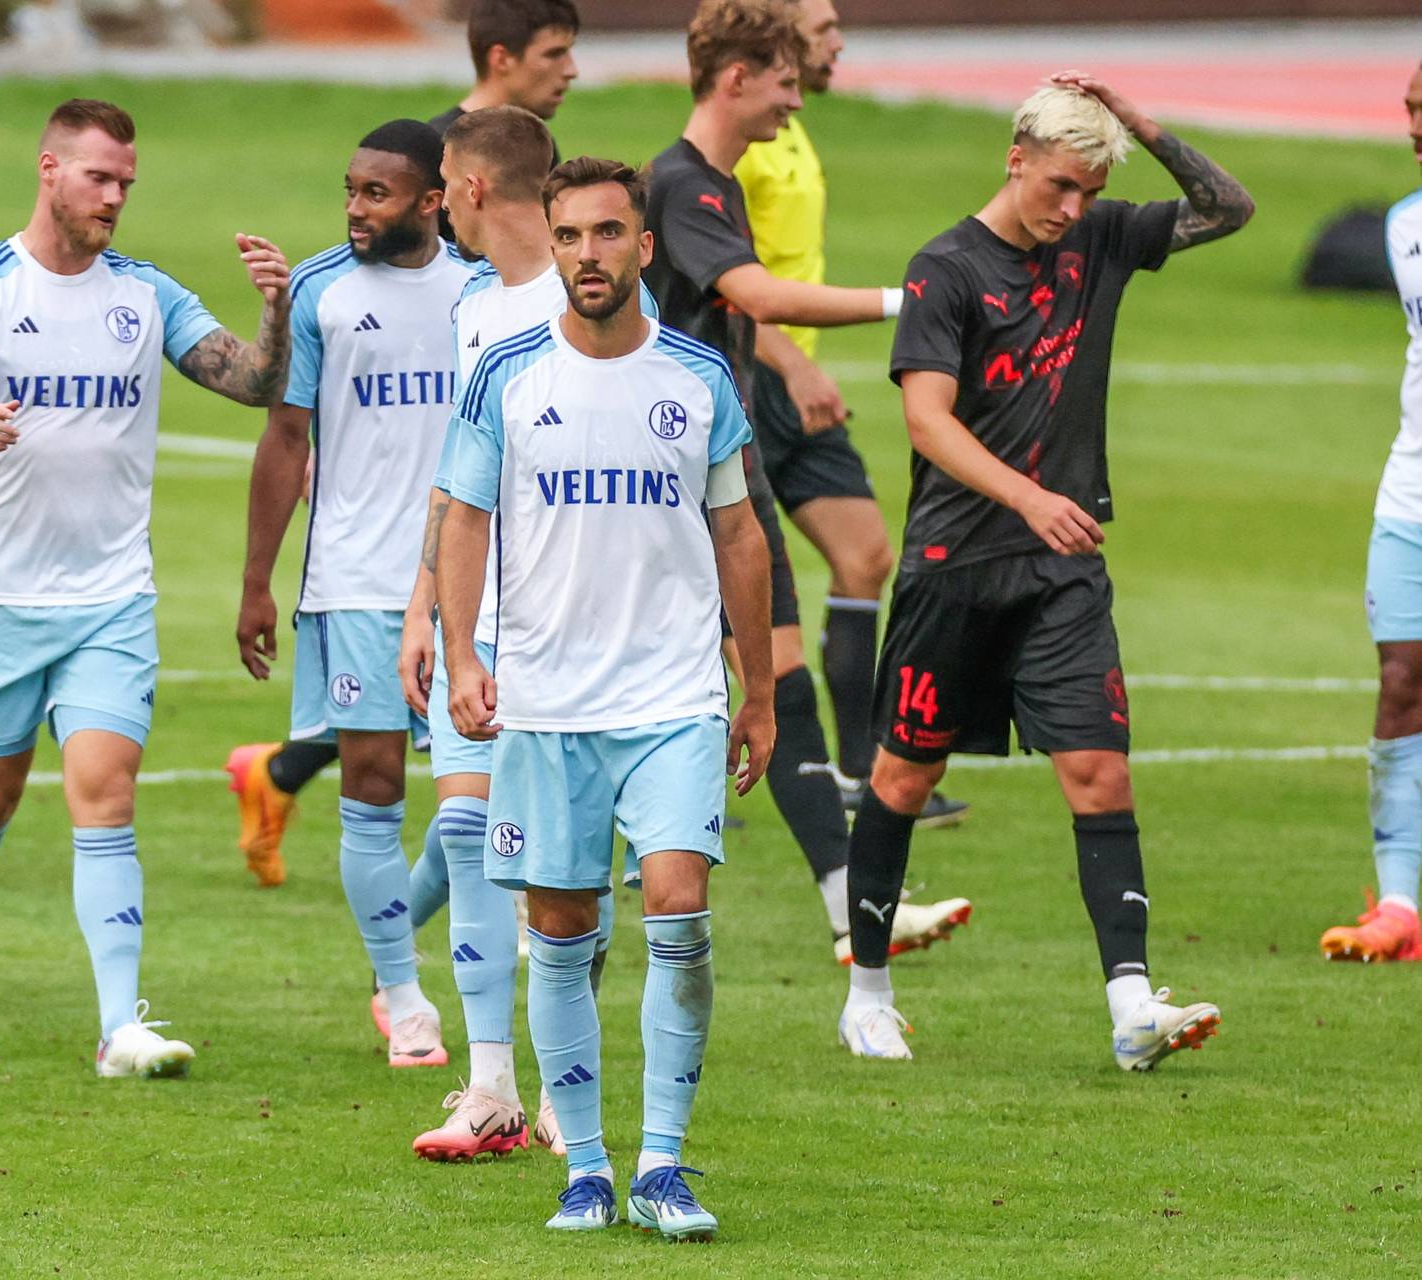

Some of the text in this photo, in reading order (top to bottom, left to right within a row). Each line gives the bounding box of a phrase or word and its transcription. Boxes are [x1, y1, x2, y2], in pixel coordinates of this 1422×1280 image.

[6, 375, 141, 408] VELTINS
[537, 469, 681, 508] VELTINS
[898, 666, 940, 726] 14
